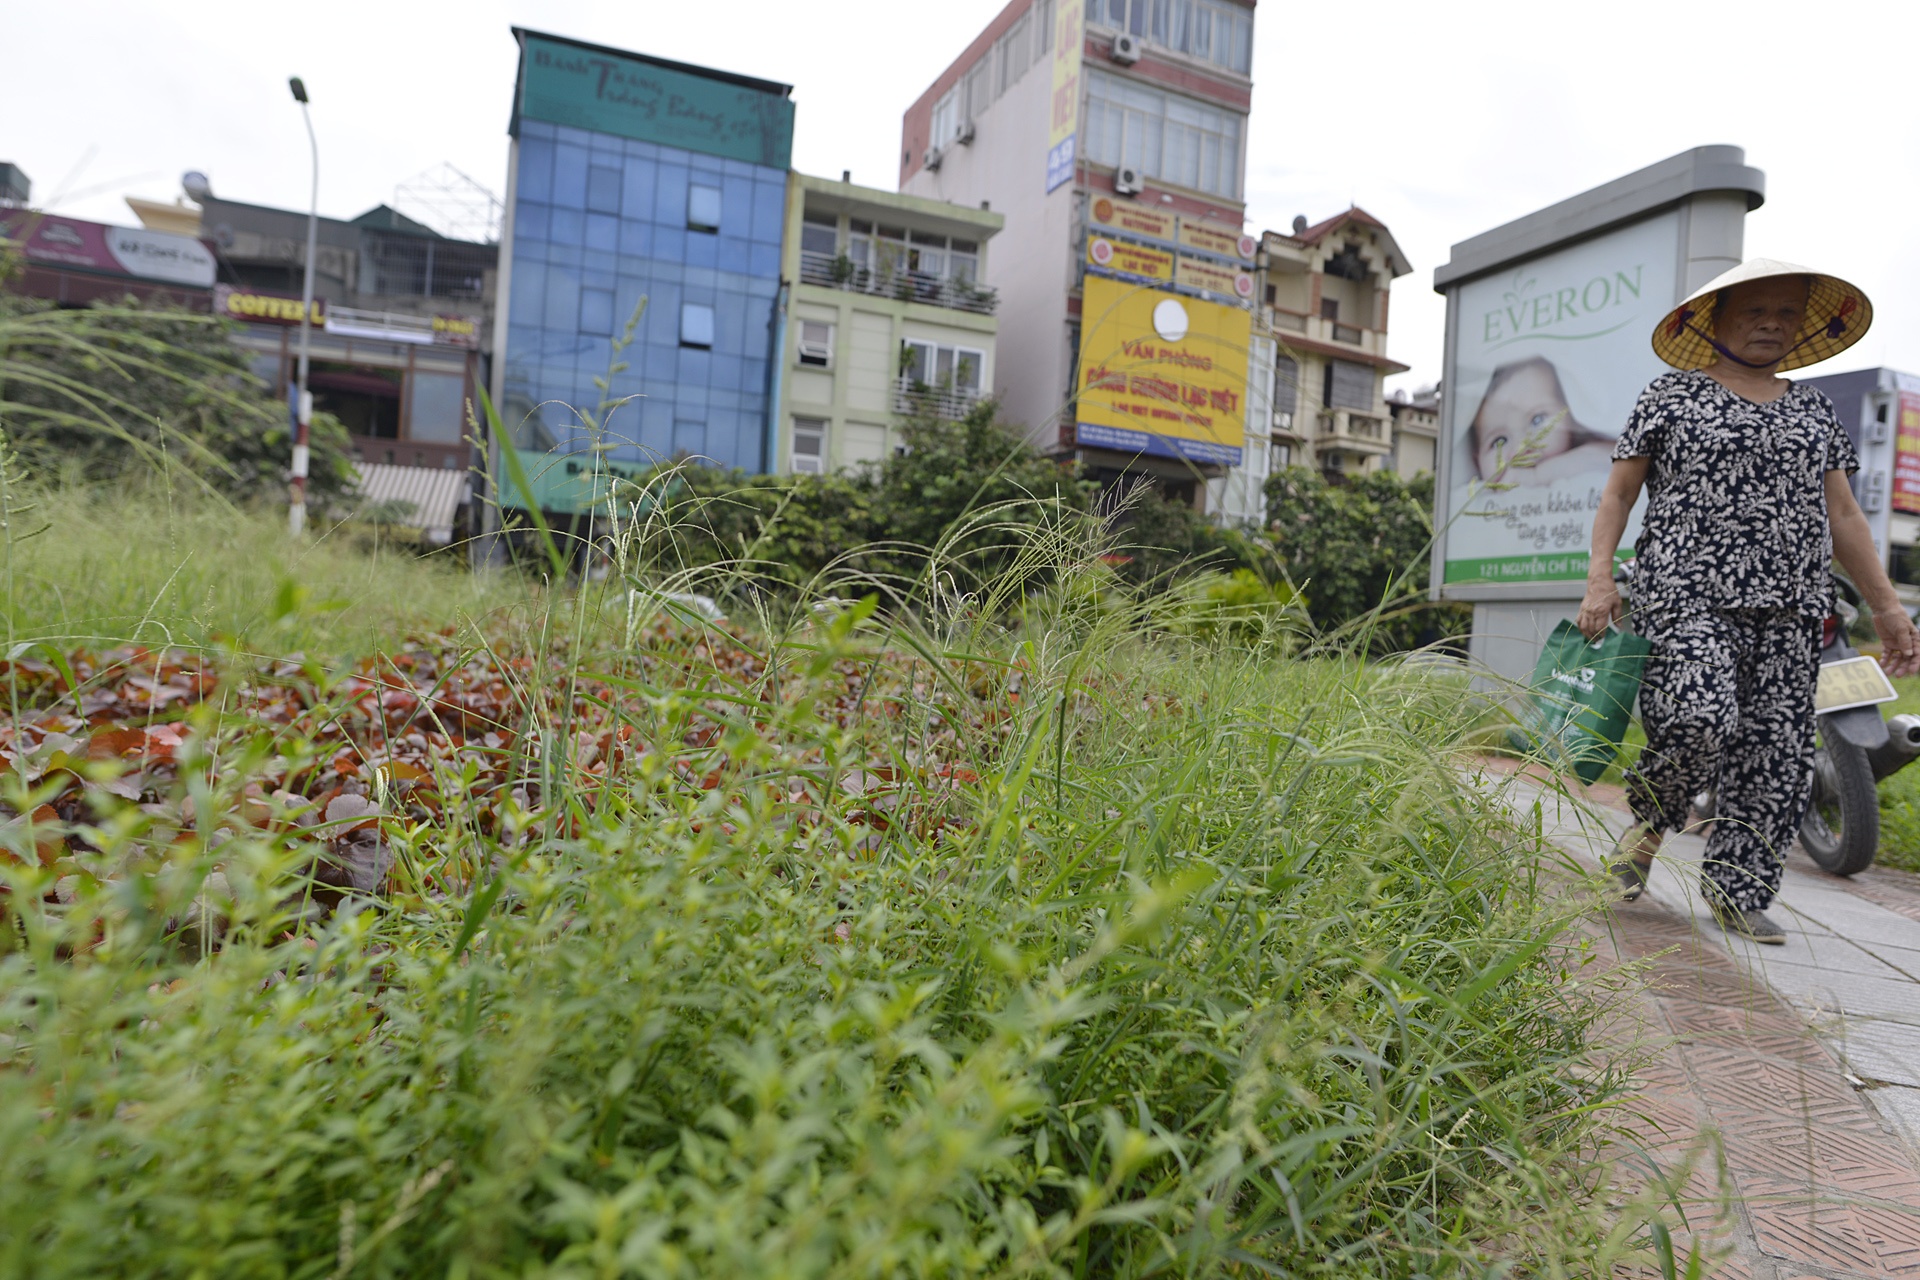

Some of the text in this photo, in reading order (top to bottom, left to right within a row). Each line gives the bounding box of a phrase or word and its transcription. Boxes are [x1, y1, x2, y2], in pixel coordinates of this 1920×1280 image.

[1483, 264, 1645, 343] EVERON
[1480, 563, 1500, 577] 121
[1548, 558, 1568, 574] CHÍ
